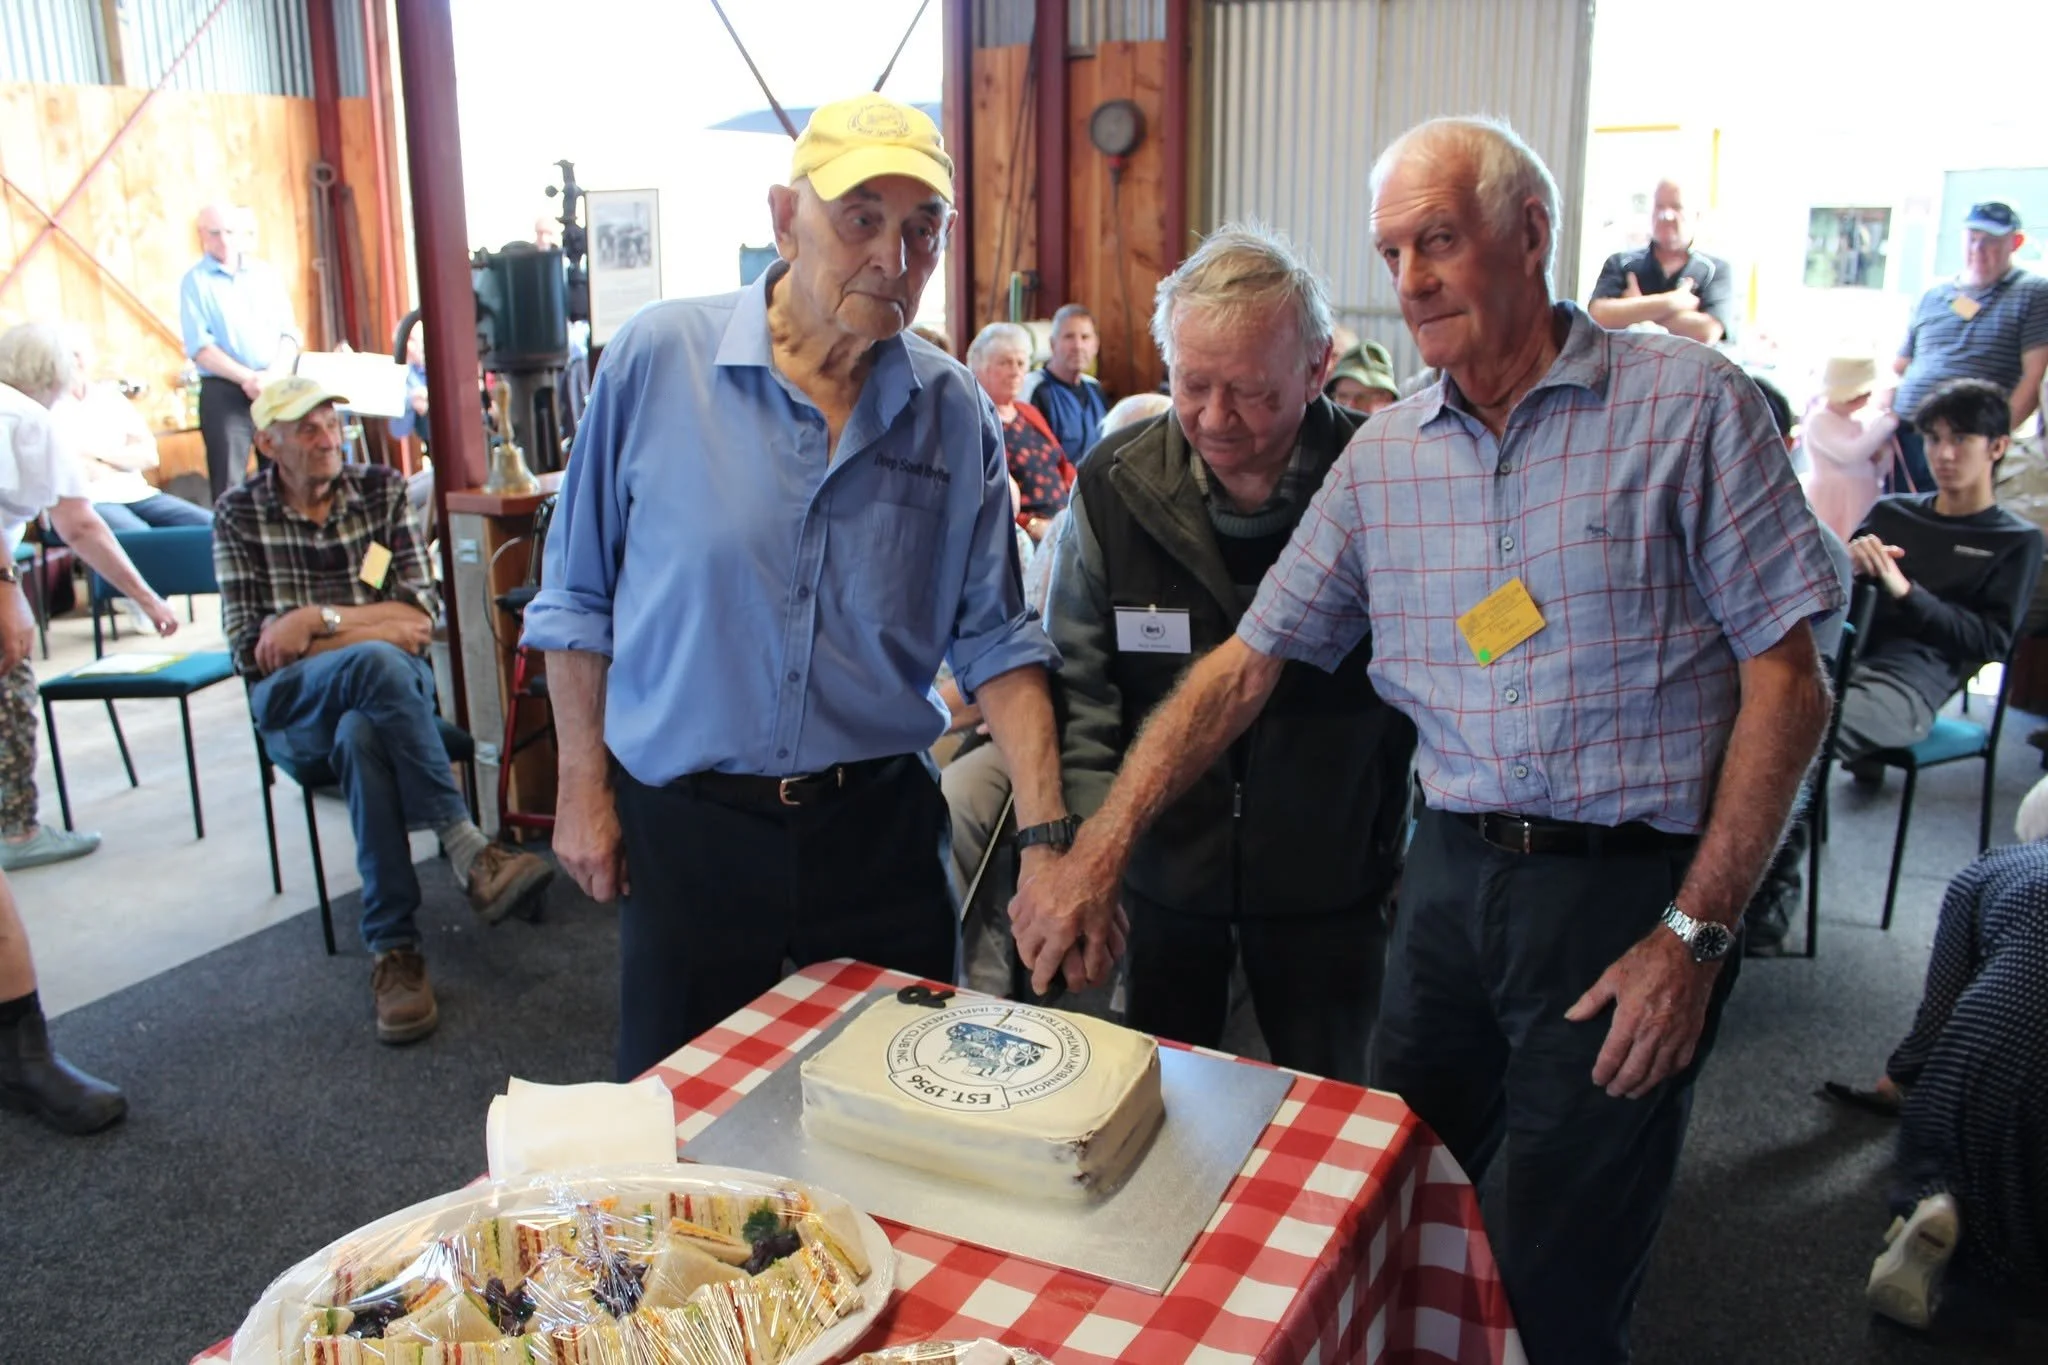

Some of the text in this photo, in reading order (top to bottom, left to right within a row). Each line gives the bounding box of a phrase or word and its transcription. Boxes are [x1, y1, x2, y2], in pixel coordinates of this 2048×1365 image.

[917, 1006, 989, 1031] IMPLEMENT
[898, 1029, 920, 1049] CLUB
[1058, 1025, 1081, 1059] VINTAGE
[908, 1074, 992, 1105] EST. 1956
[1015, 1059, 1080, 1097] THORNBURY
